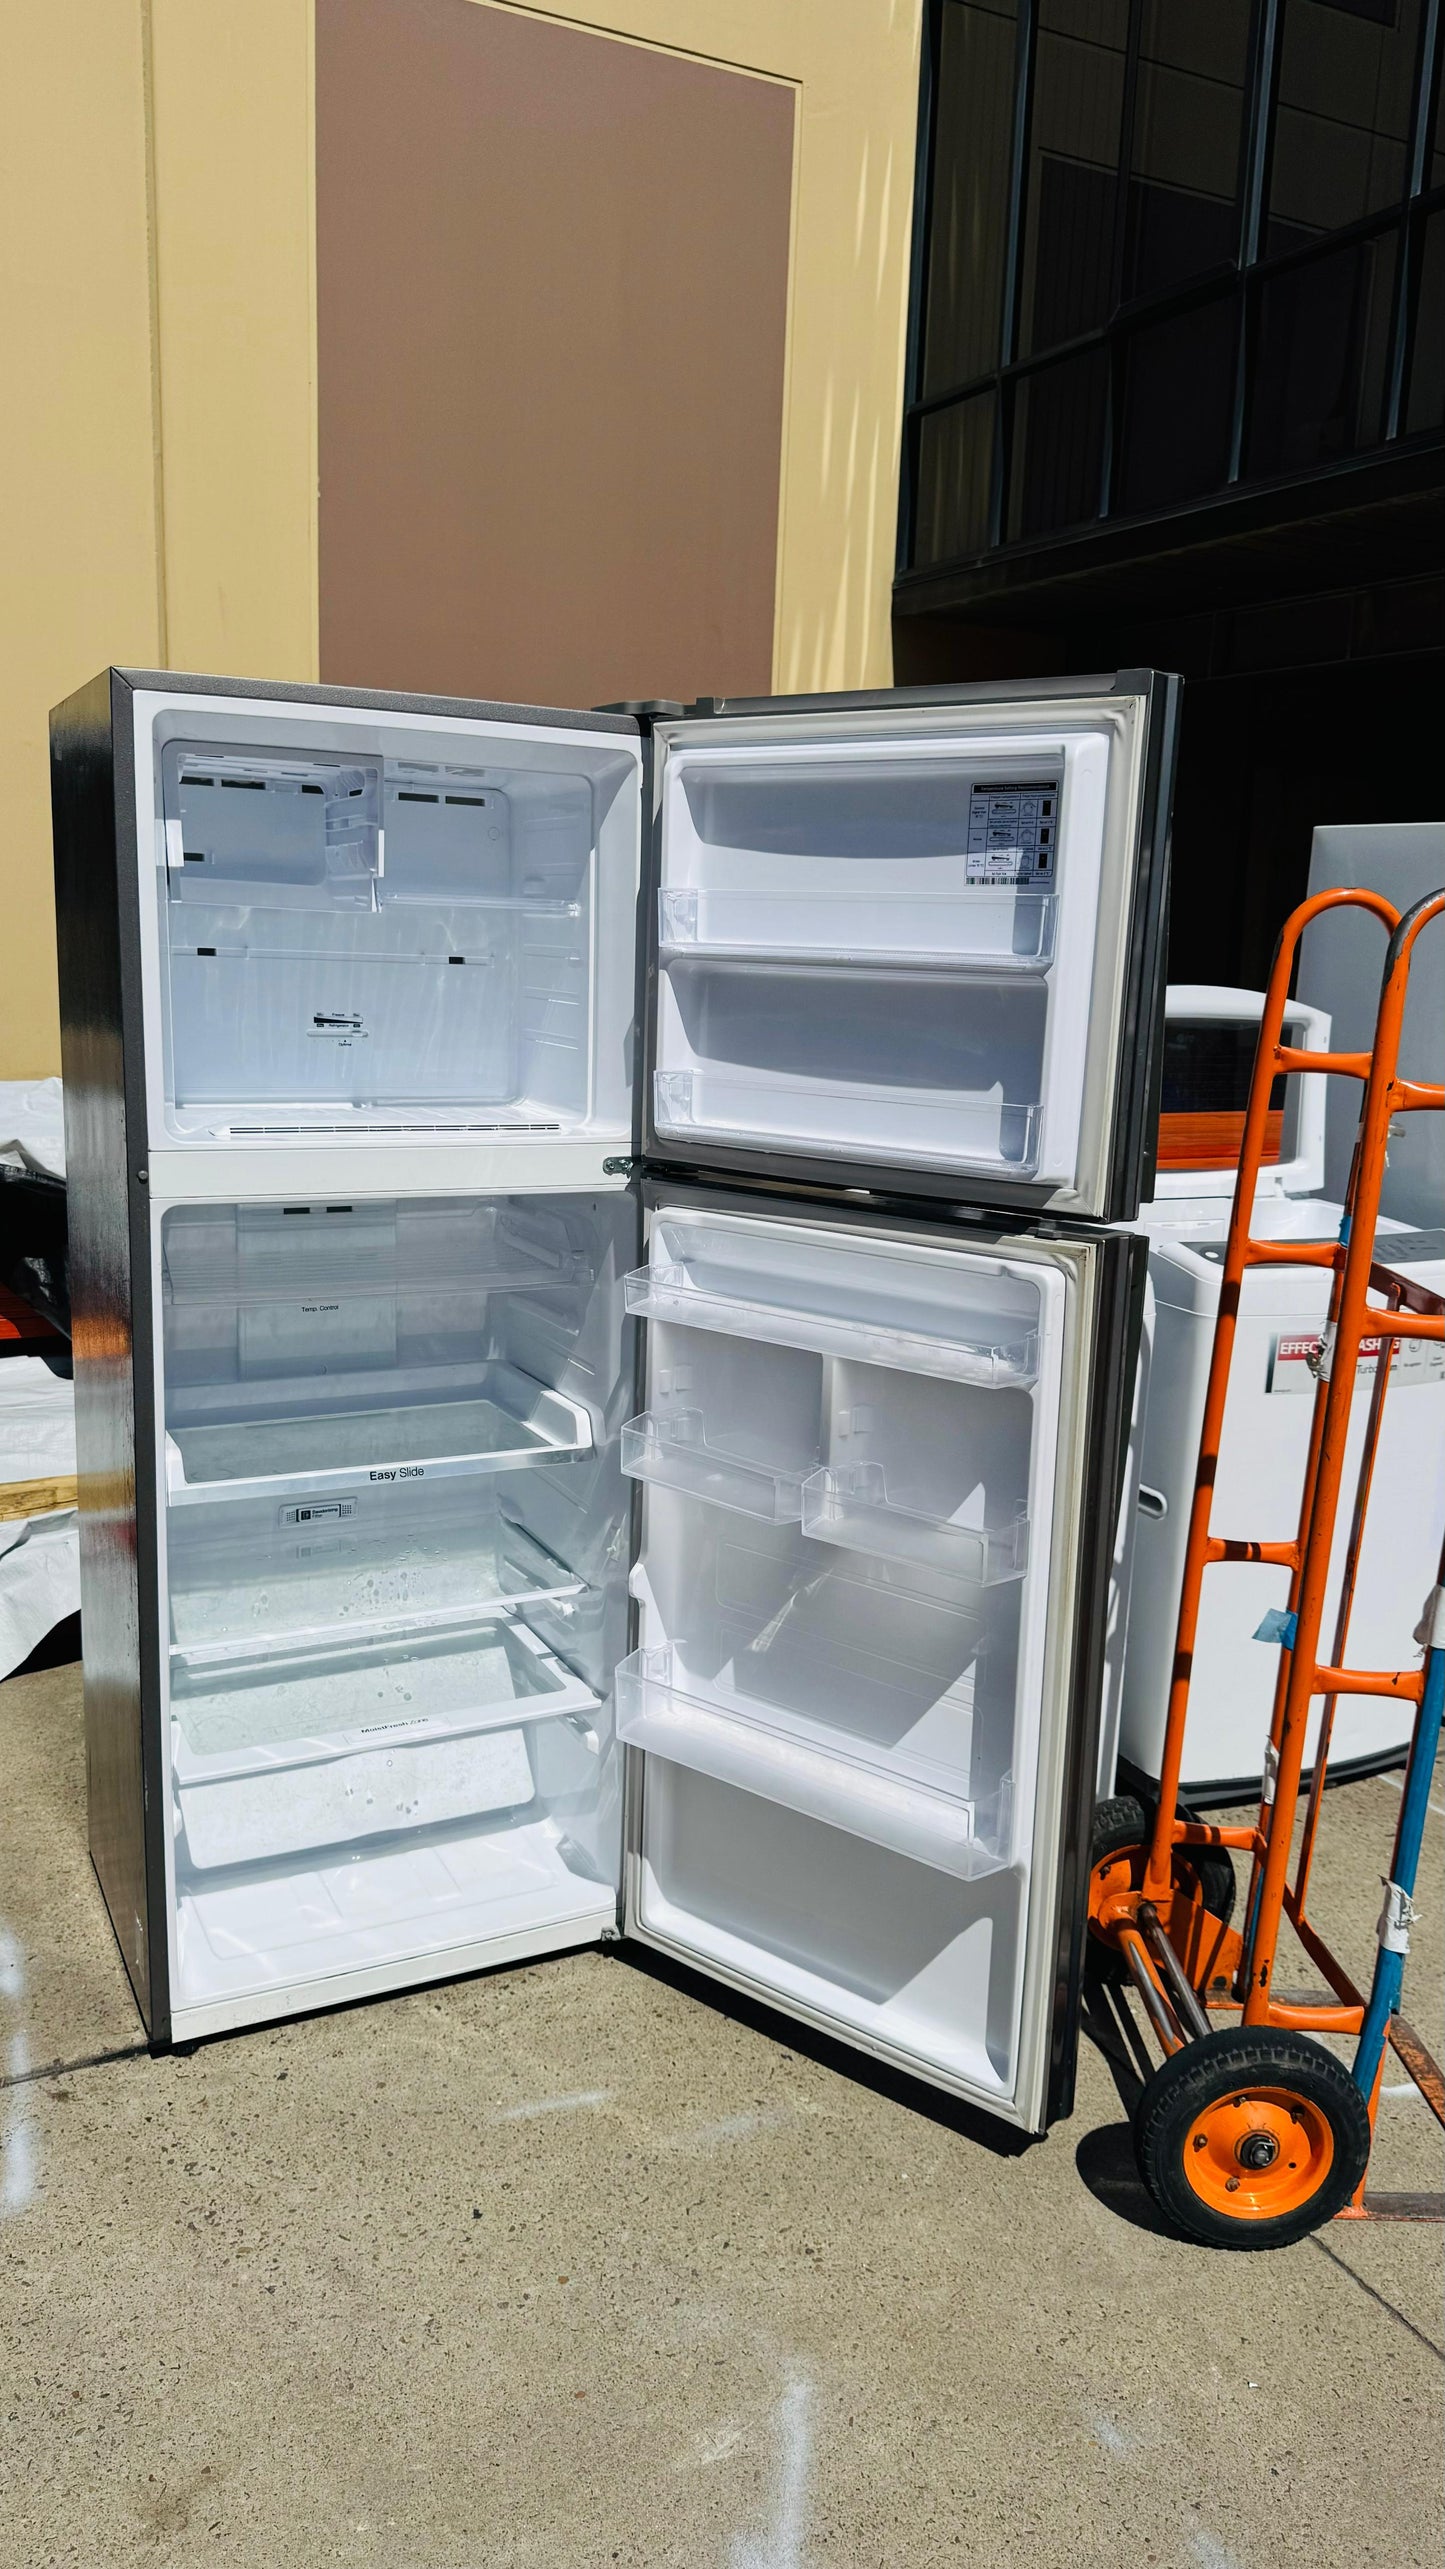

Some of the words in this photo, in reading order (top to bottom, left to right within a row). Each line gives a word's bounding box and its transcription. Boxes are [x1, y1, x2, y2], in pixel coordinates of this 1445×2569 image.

[319, 1304, 339, 1312] Control
[1280, 1341, 1319, 1355] EFFEC
[369, 1471, 397, 1481] Easy
[399, 1466, 425, 1478] Slide
